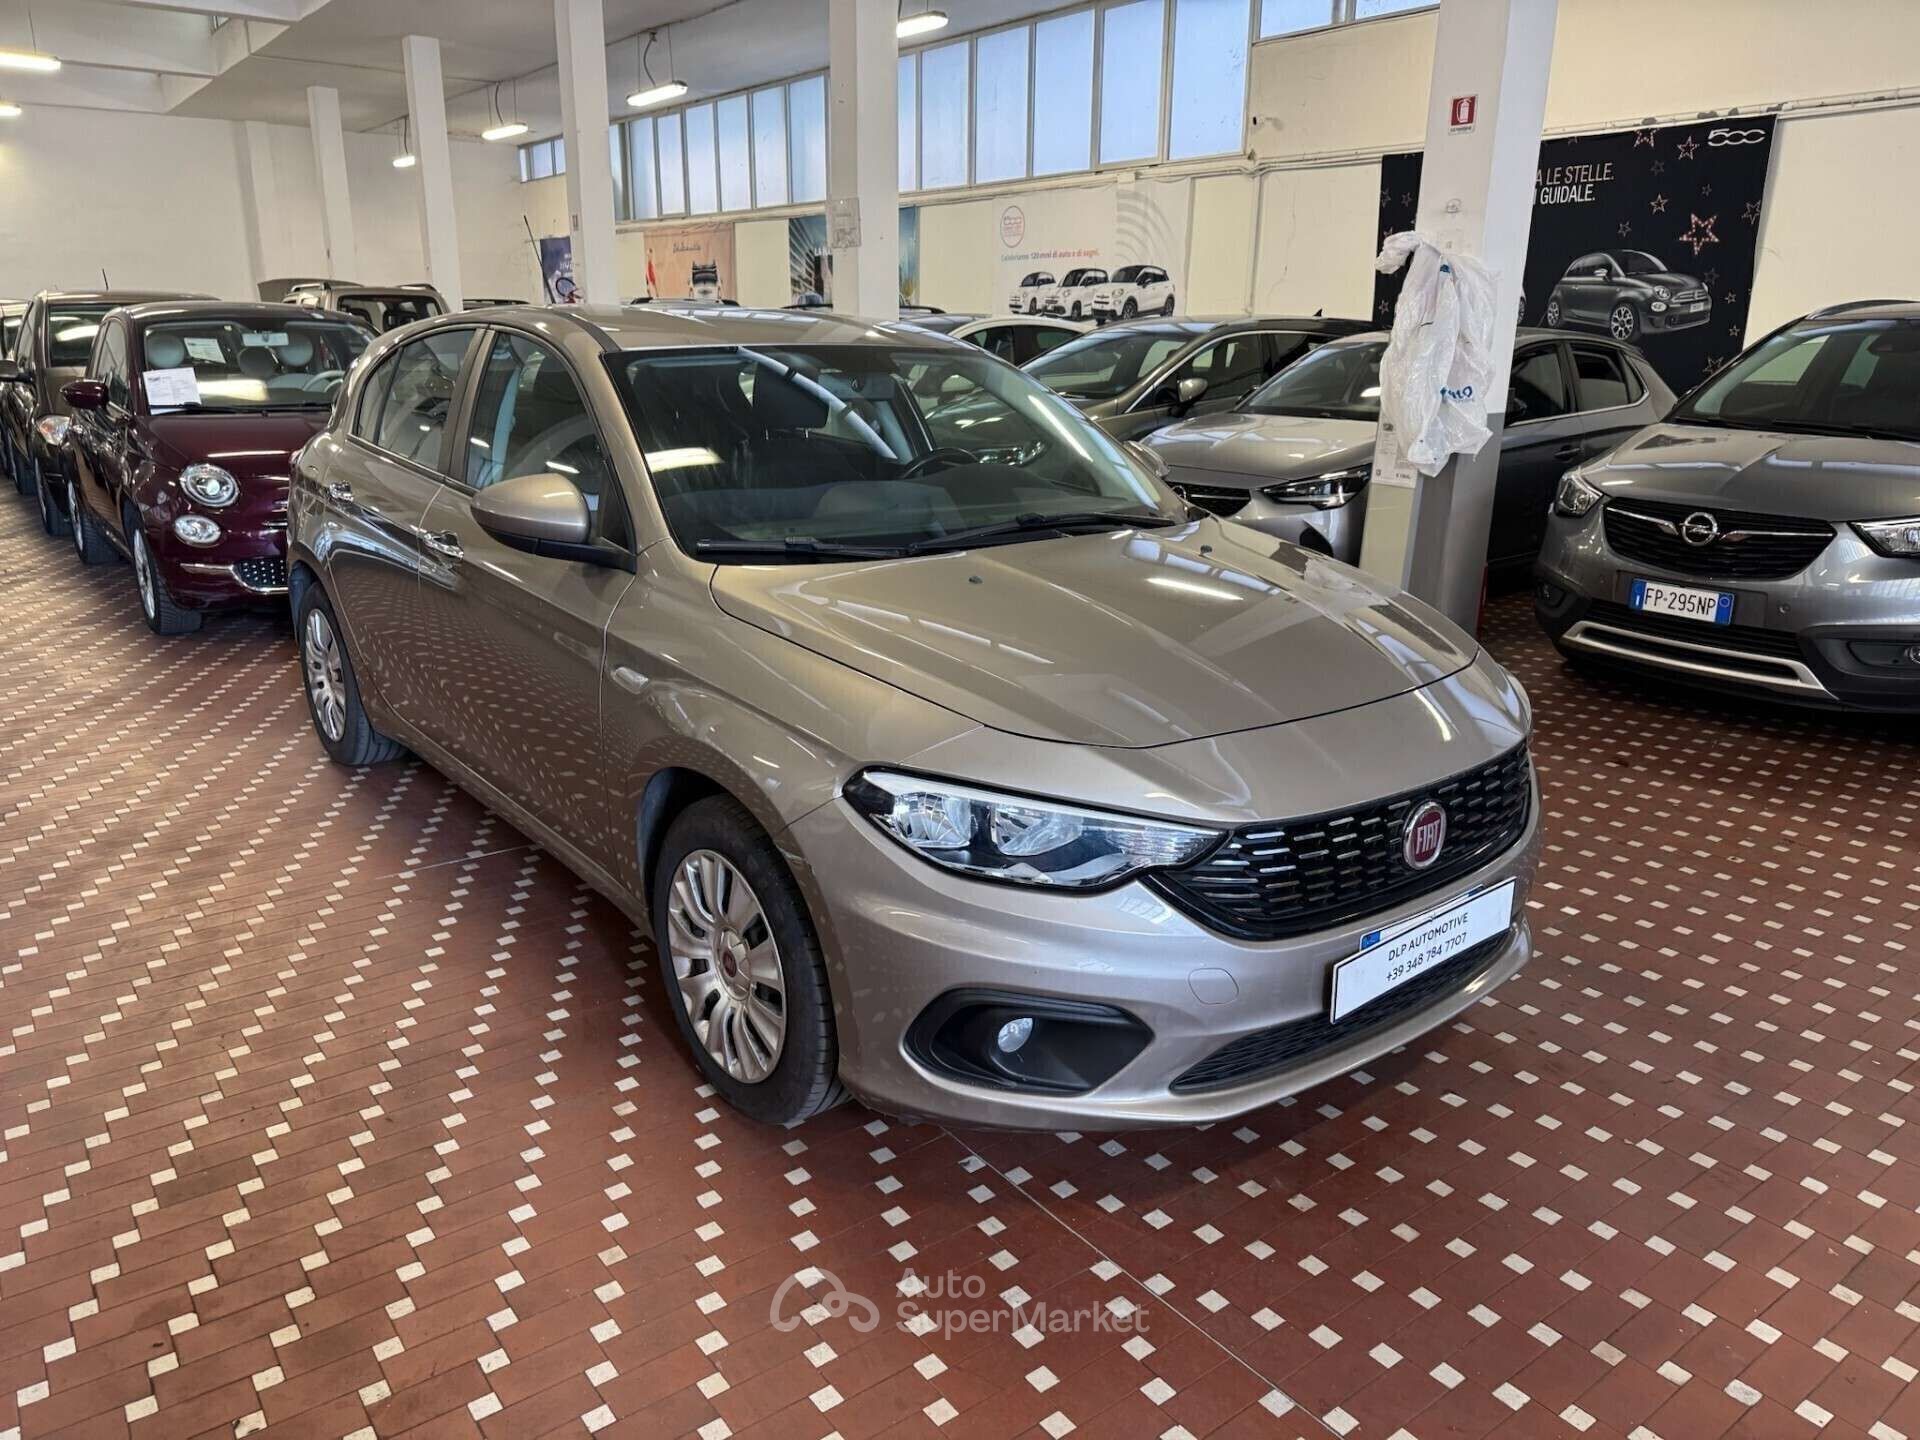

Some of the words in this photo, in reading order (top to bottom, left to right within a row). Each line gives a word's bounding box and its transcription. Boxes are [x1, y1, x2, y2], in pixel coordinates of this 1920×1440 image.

[1707, 127, 1766, 147] 500
[1546, 166, 1562, 185] LE
[1564, 162, 1615, 184] STELLE.
[1540, 183, 1596, 205] GUIDALE.
[1416, 819, 1440, 854] FIAT
[1388, 944, 1407, 961] DLP
[1408, 912, 1468, 951] AUTOMOTIVE
[1386, 964, 1404, 981] +39
[1405, 953, 1424, 973] 348
[1426, 945, 1442, 962] 784
[1445, 932, 1467, 952] 7707
